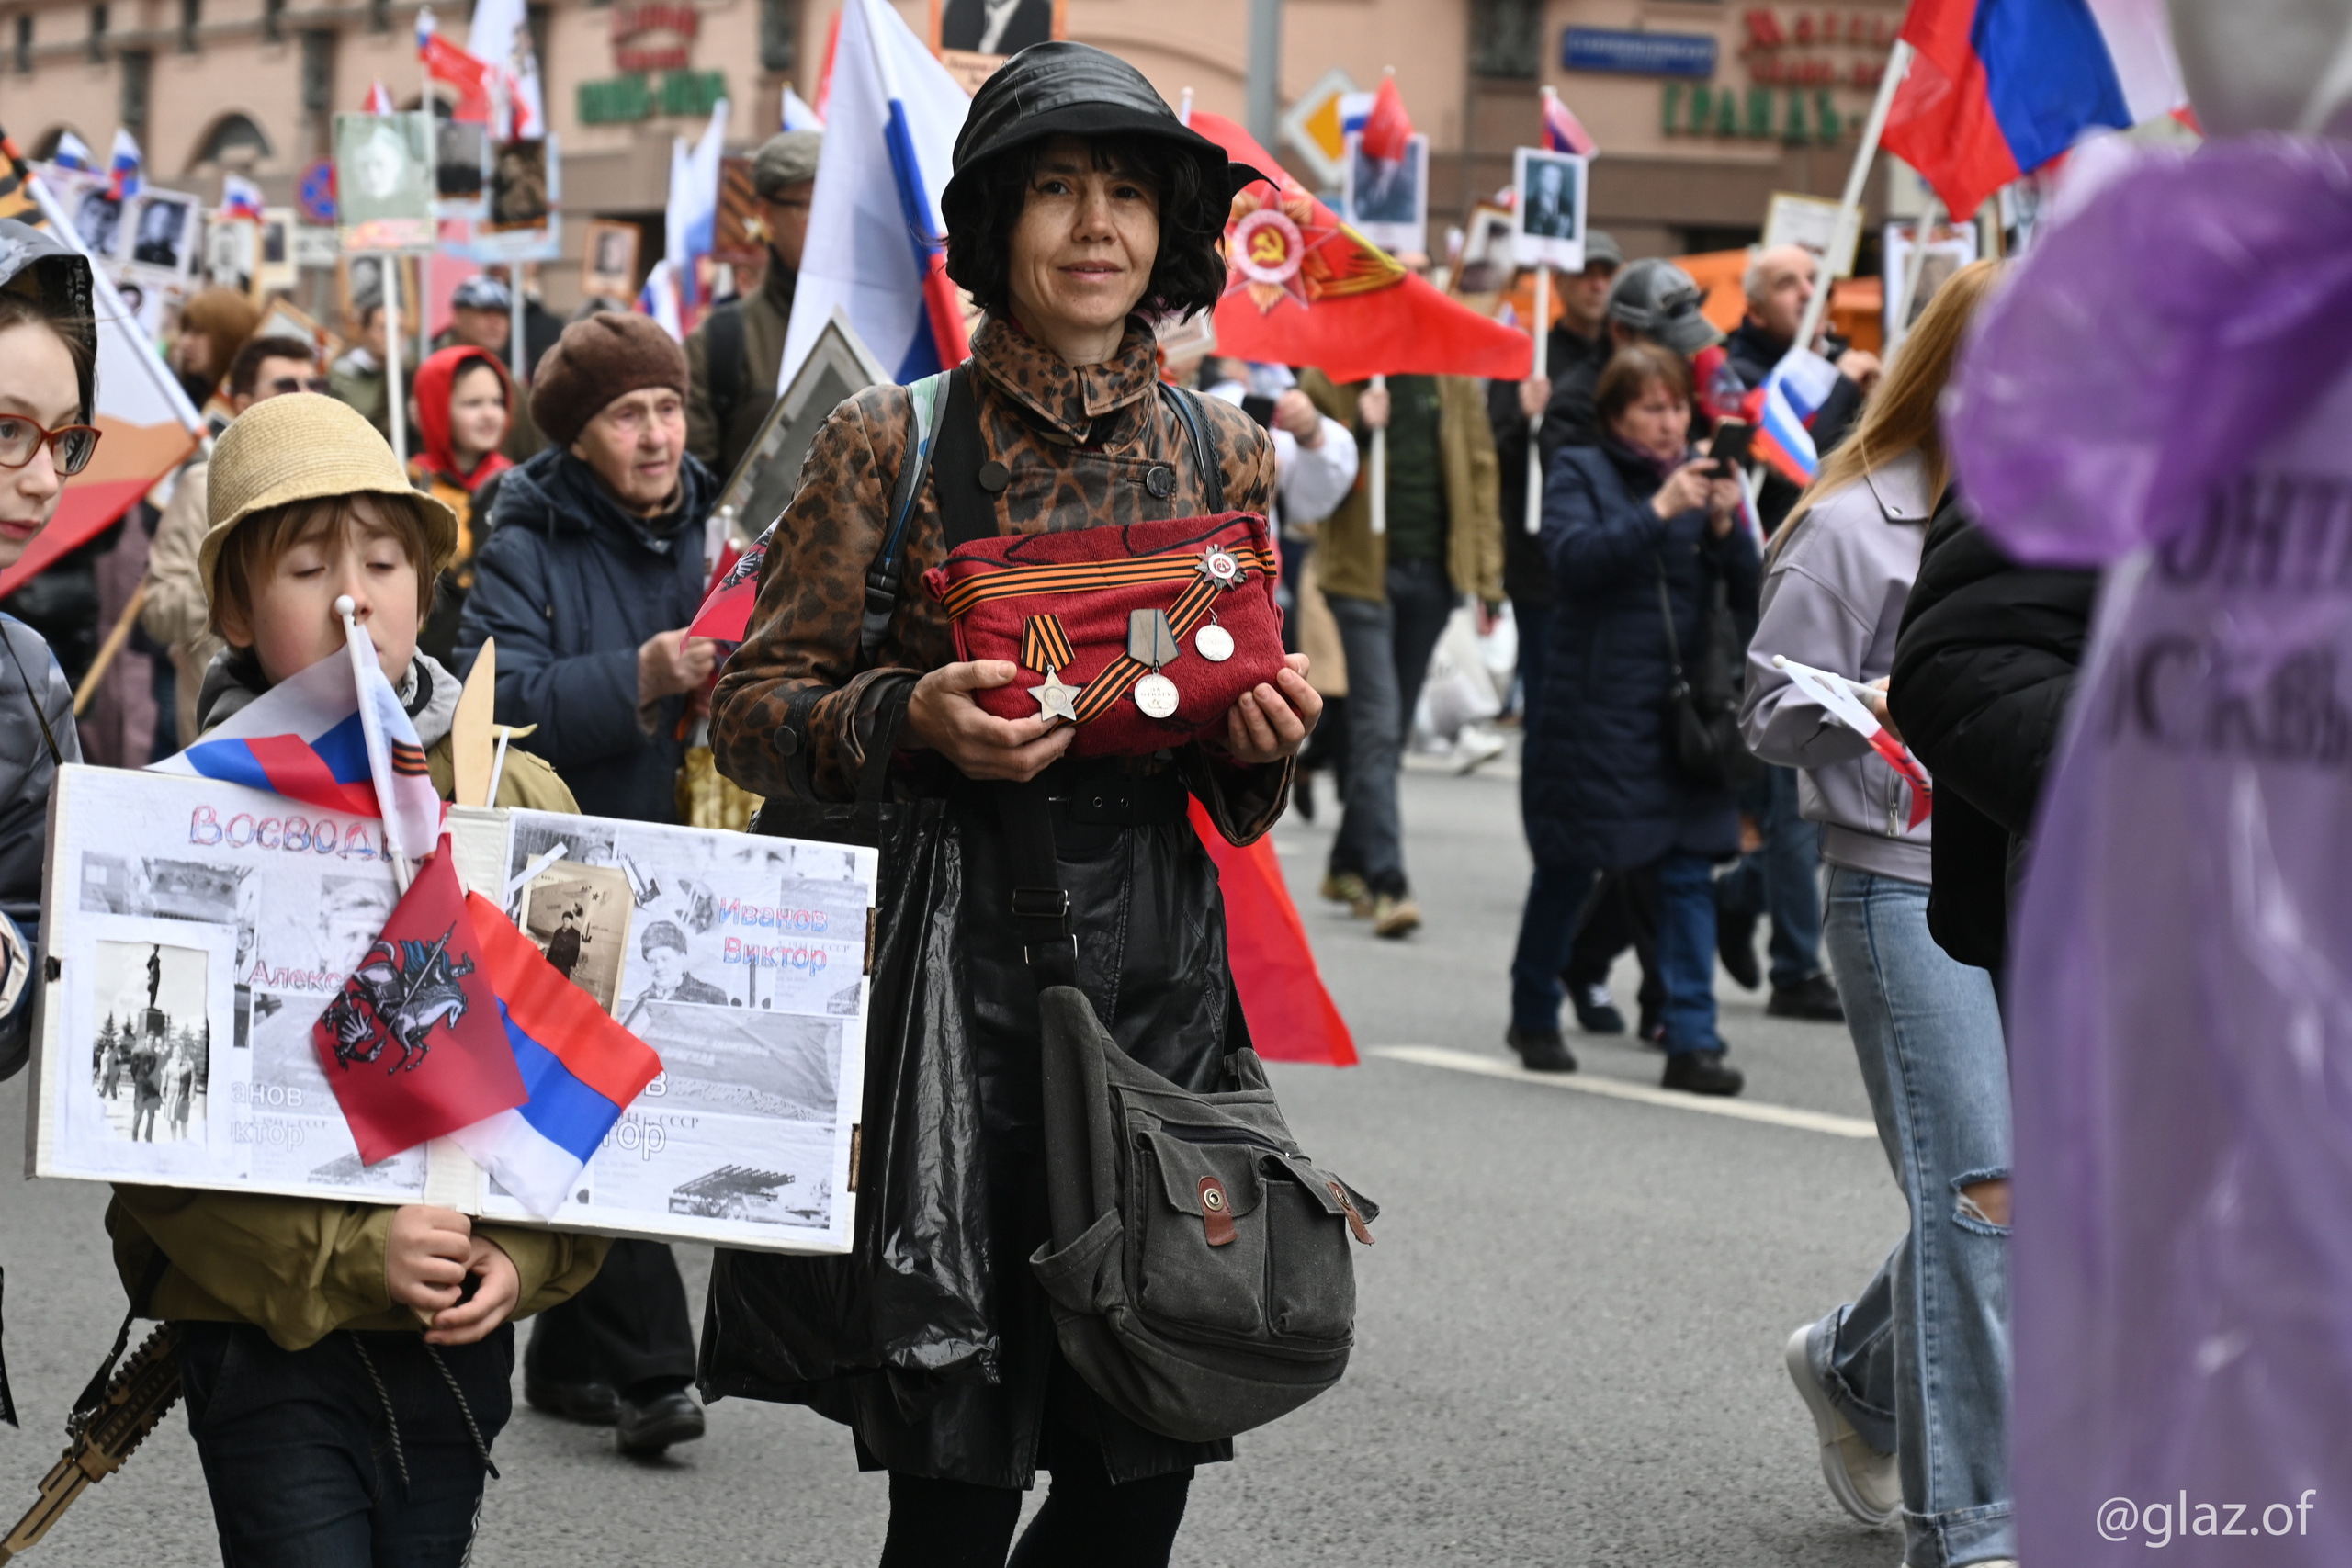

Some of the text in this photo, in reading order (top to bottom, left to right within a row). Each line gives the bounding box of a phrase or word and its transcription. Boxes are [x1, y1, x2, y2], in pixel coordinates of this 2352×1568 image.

[189, 805, 424, 864] Воевод
[719, 897, 829, 932] Иванов
[723, 937, 827, 977] Виктор
[247, 960, 348, 993] Алекс
[231, 1120, 305, 1153] ктор
[659, 1114, 699, 1129] СССР
